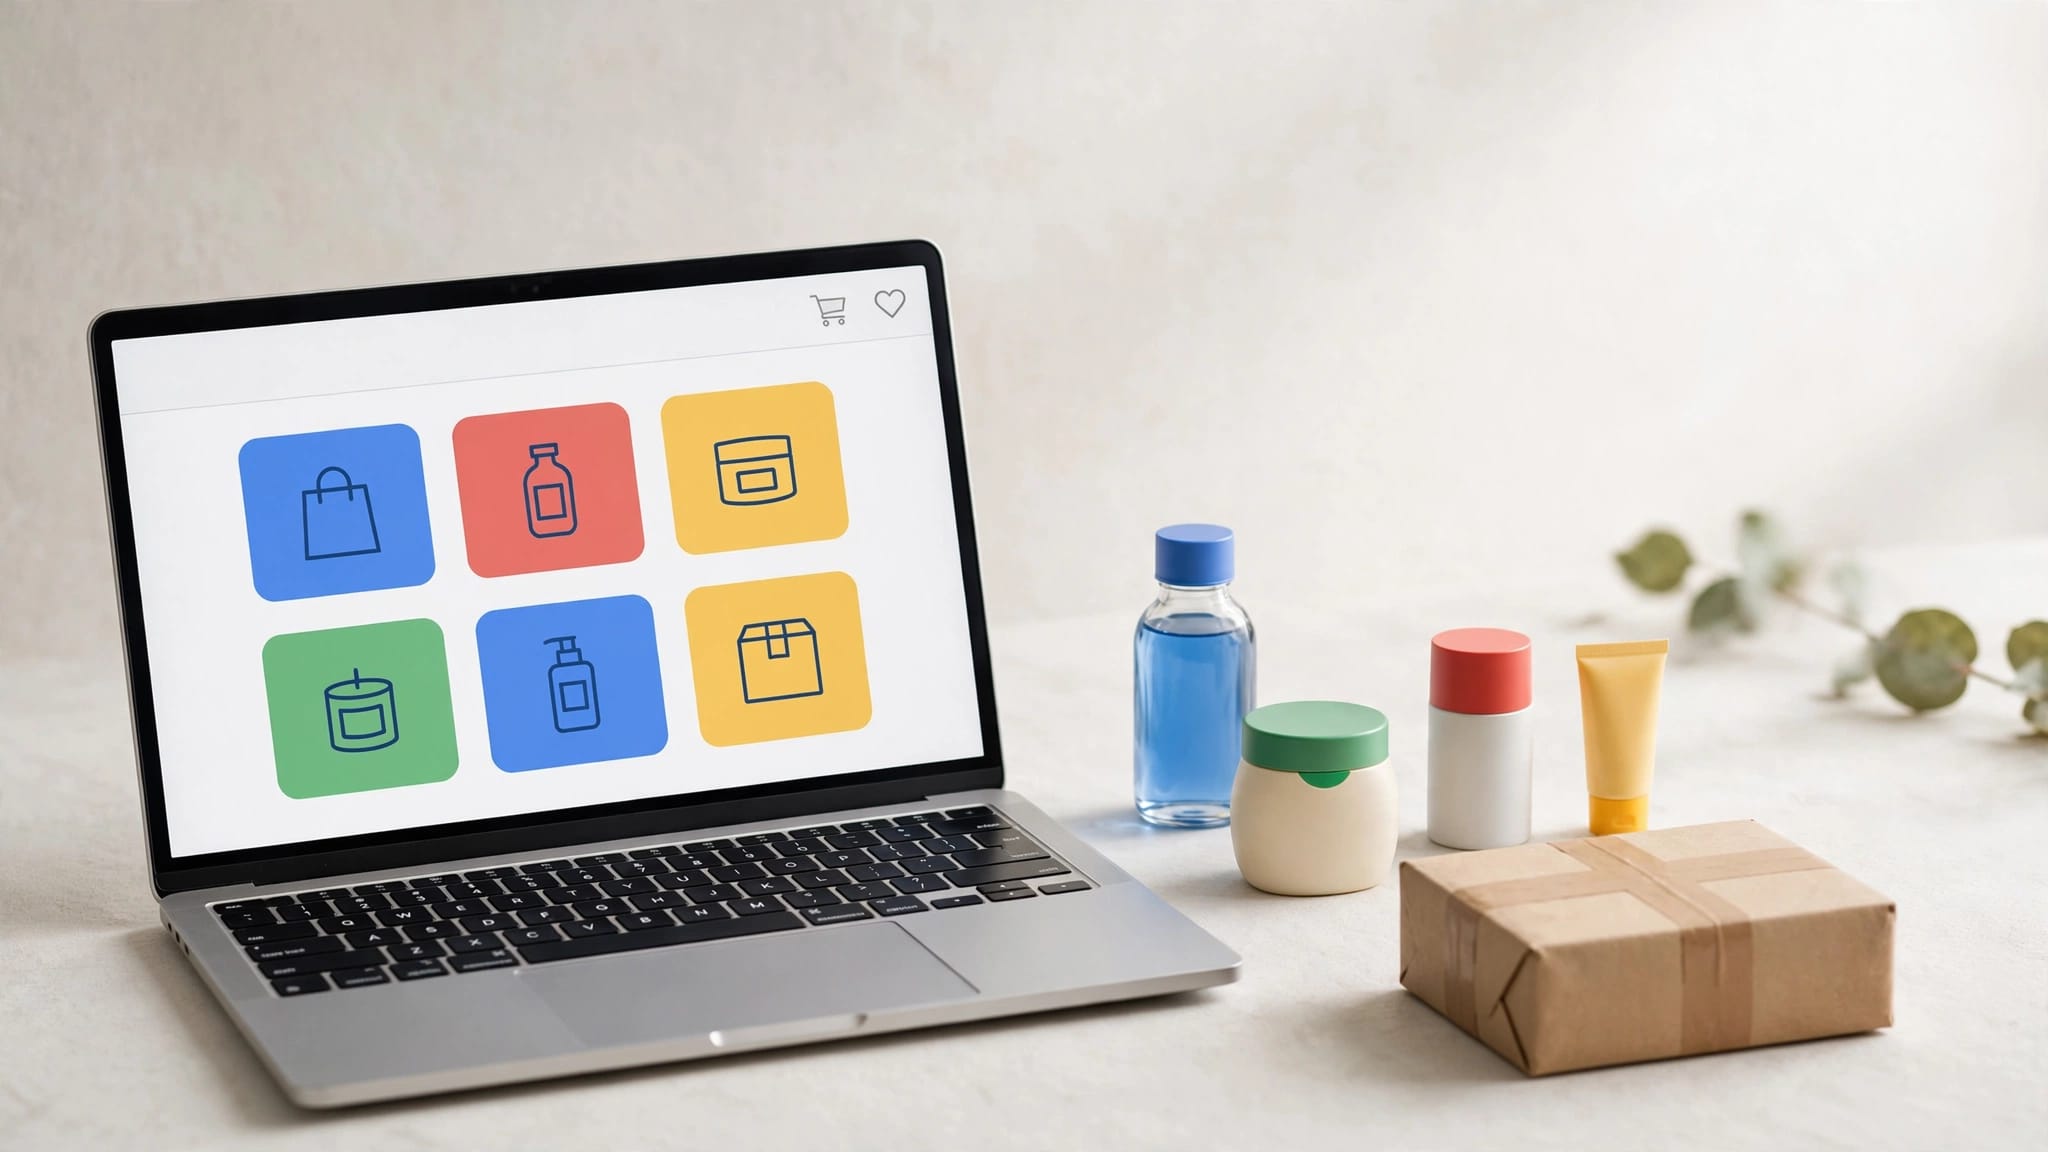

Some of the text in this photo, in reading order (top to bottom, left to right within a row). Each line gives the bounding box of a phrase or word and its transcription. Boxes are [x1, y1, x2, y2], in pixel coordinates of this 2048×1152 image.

[749, 901, 765, 909] M
[396, 911, 411, 919] W
[694, 908, 708, 916] N
[582, 923, 594, 931] V
[468, 938, 482, 946] X
[410, 946, 423, 955] Z
